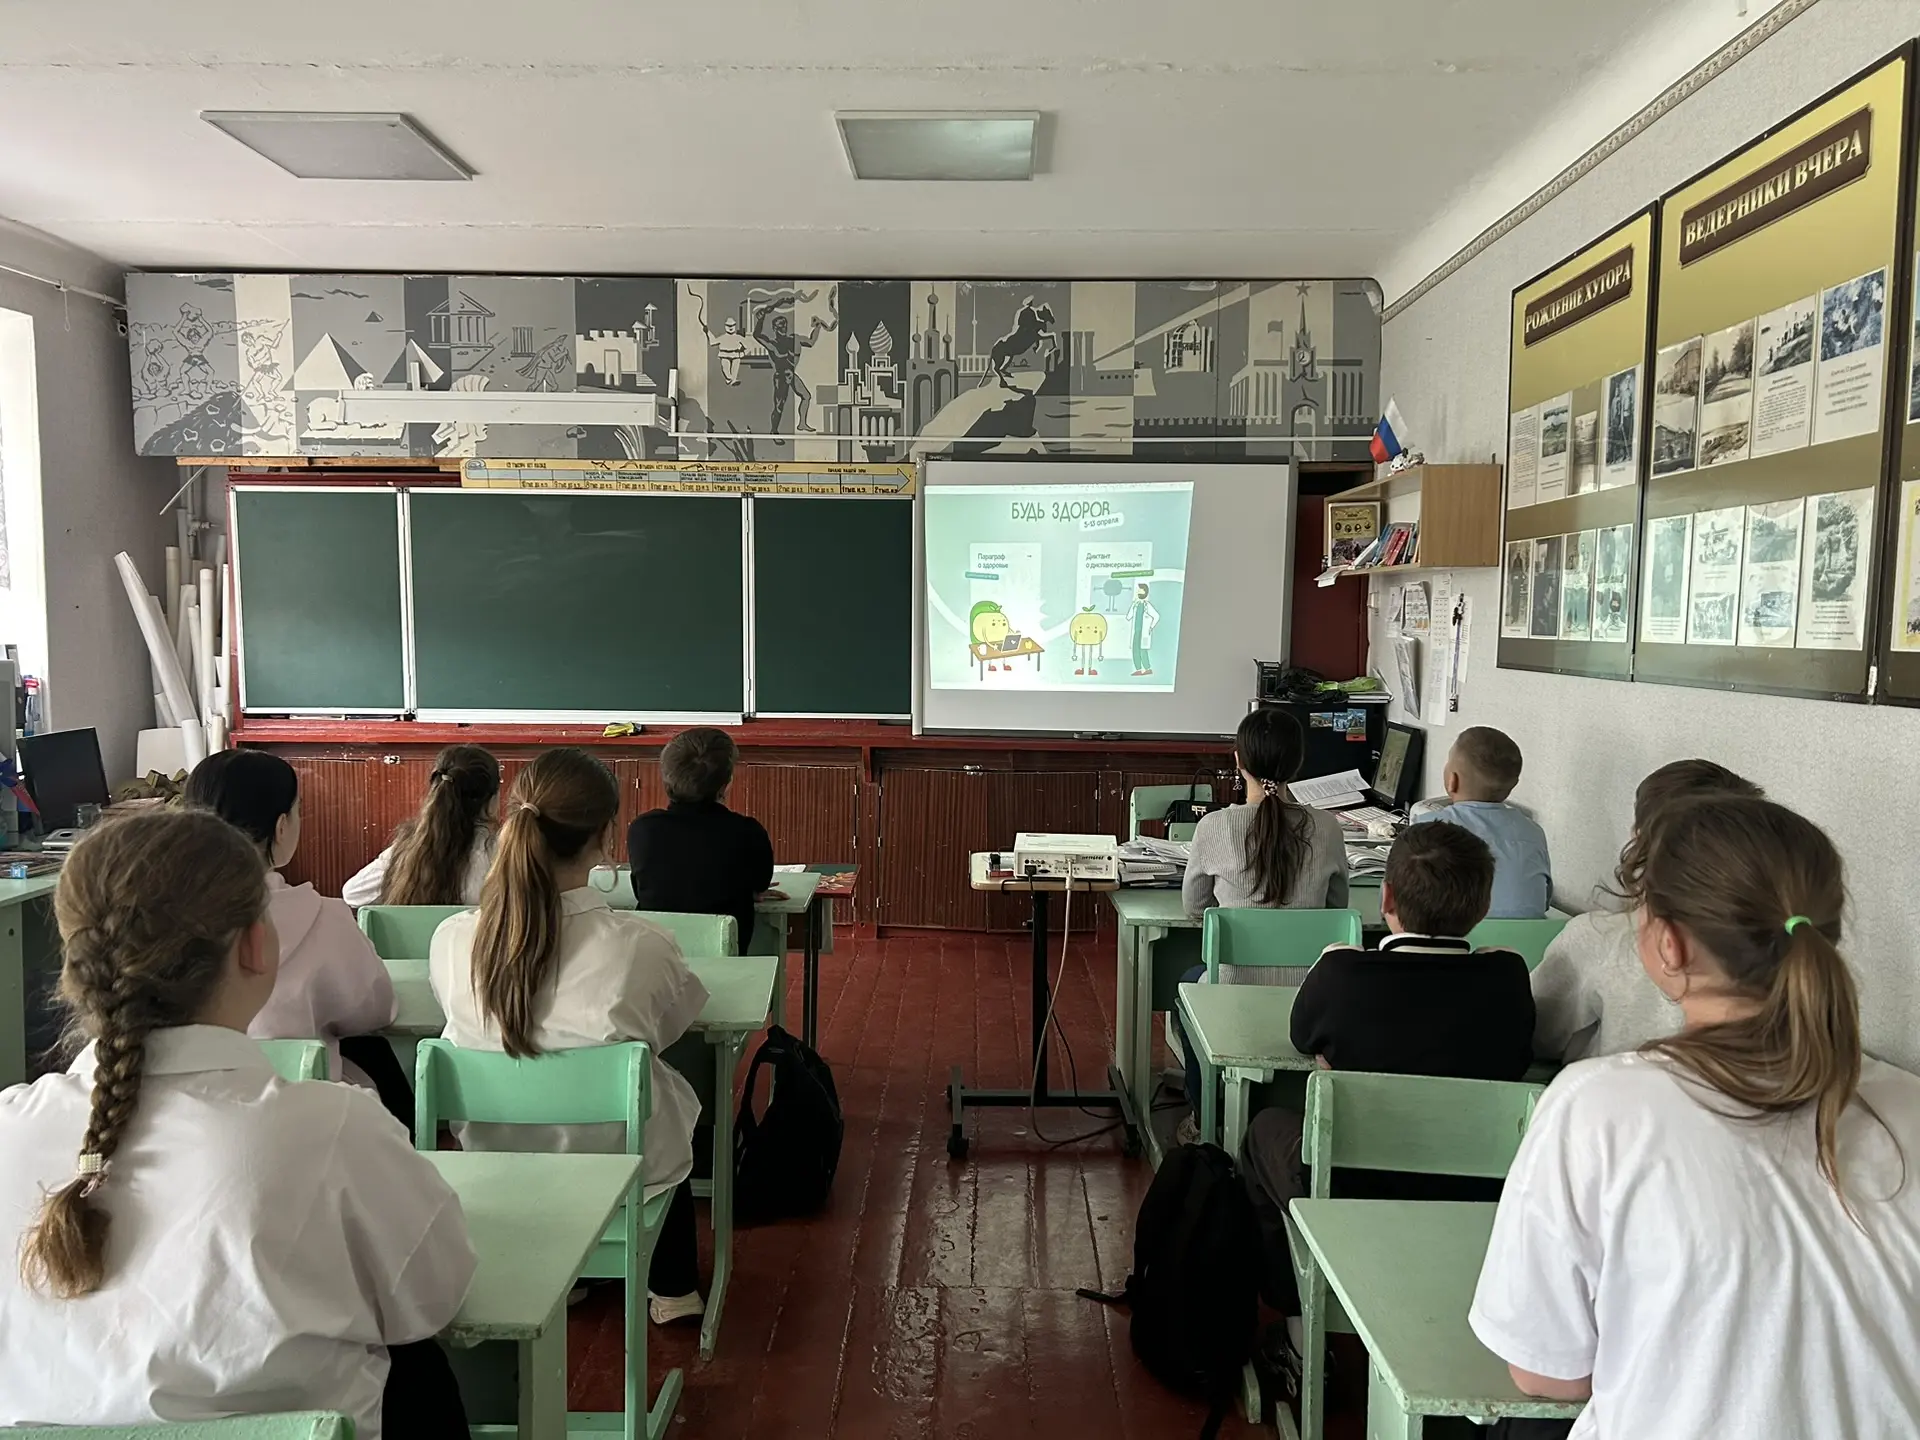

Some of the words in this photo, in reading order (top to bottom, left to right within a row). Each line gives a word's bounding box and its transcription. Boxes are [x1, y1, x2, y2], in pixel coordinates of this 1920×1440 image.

[1684, 167, 1792, 247] ВЕДЕРНИКИ
[1794, 129, 1863, 190] ВЧЕРА
[1525, 287, 1584, 334] РОЖДЕНИЕ
[1584, 259, 1631, 303] ХУТОРА
[1011, 501, 1045, 522] БУДЬ
[1052, 501, 1110, 522] ЗДОРОВ
[977, 552, 1006, 561] Параграф
[1085, 552, 1111, 560] Диктант
